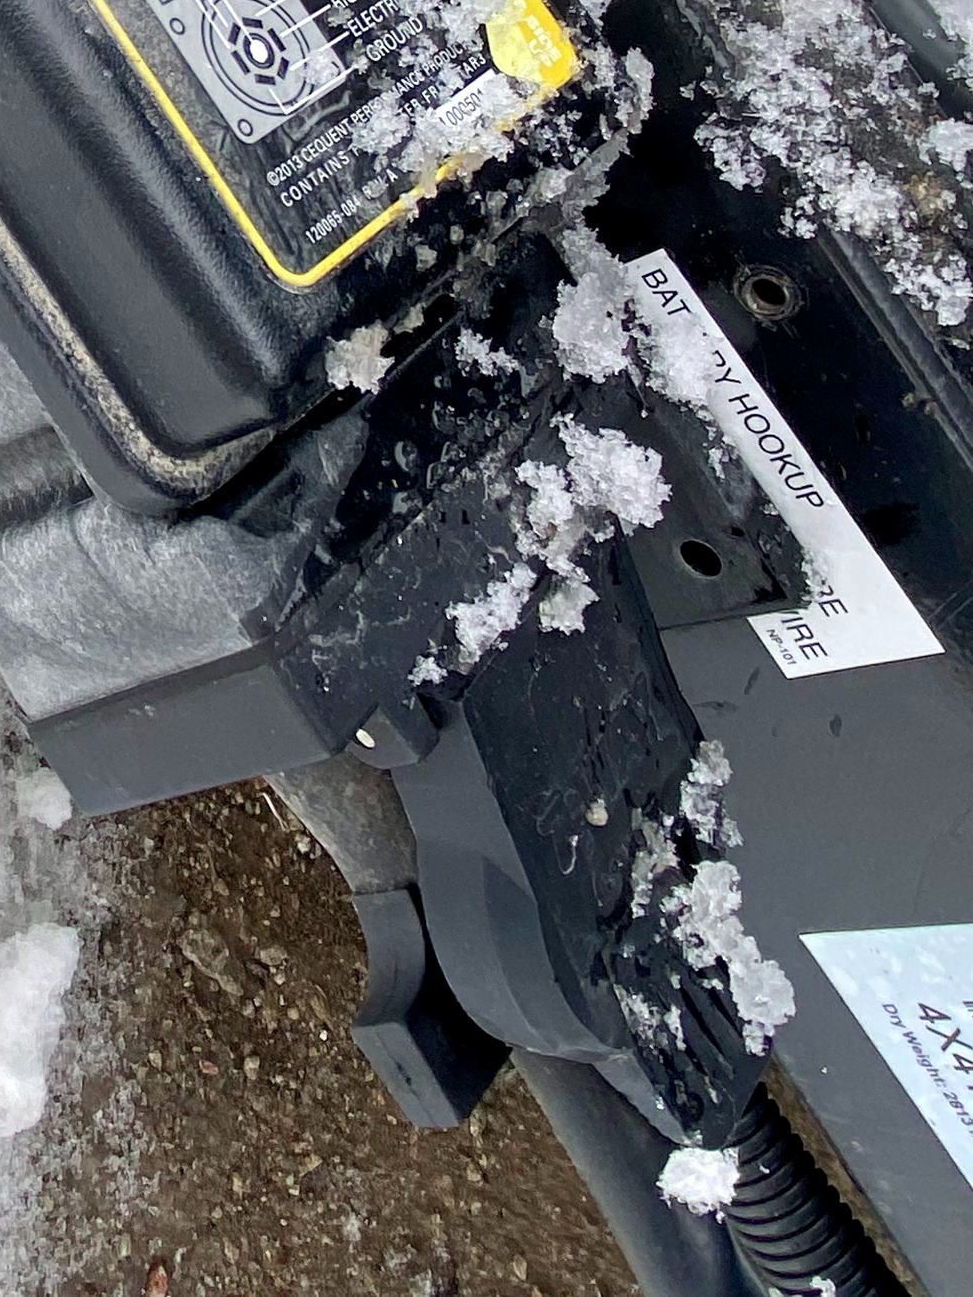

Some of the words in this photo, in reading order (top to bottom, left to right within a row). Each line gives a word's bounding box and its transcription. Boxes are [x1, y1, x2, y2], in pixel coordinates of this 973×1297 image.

[363, 12, 425, 65] GROUND
[298, 115, 356, 165] CEQUENT
[277, 147, 351, 210] CONTAINS
[728, 393, 824, 507] HOOKUP
[777, 611, 828, 662] IRE
[882, 1003, 907, 1028] Dry
[902, 1032, 948, 1088] Weight:
[918, 1002, 973, 1092] 4X4
